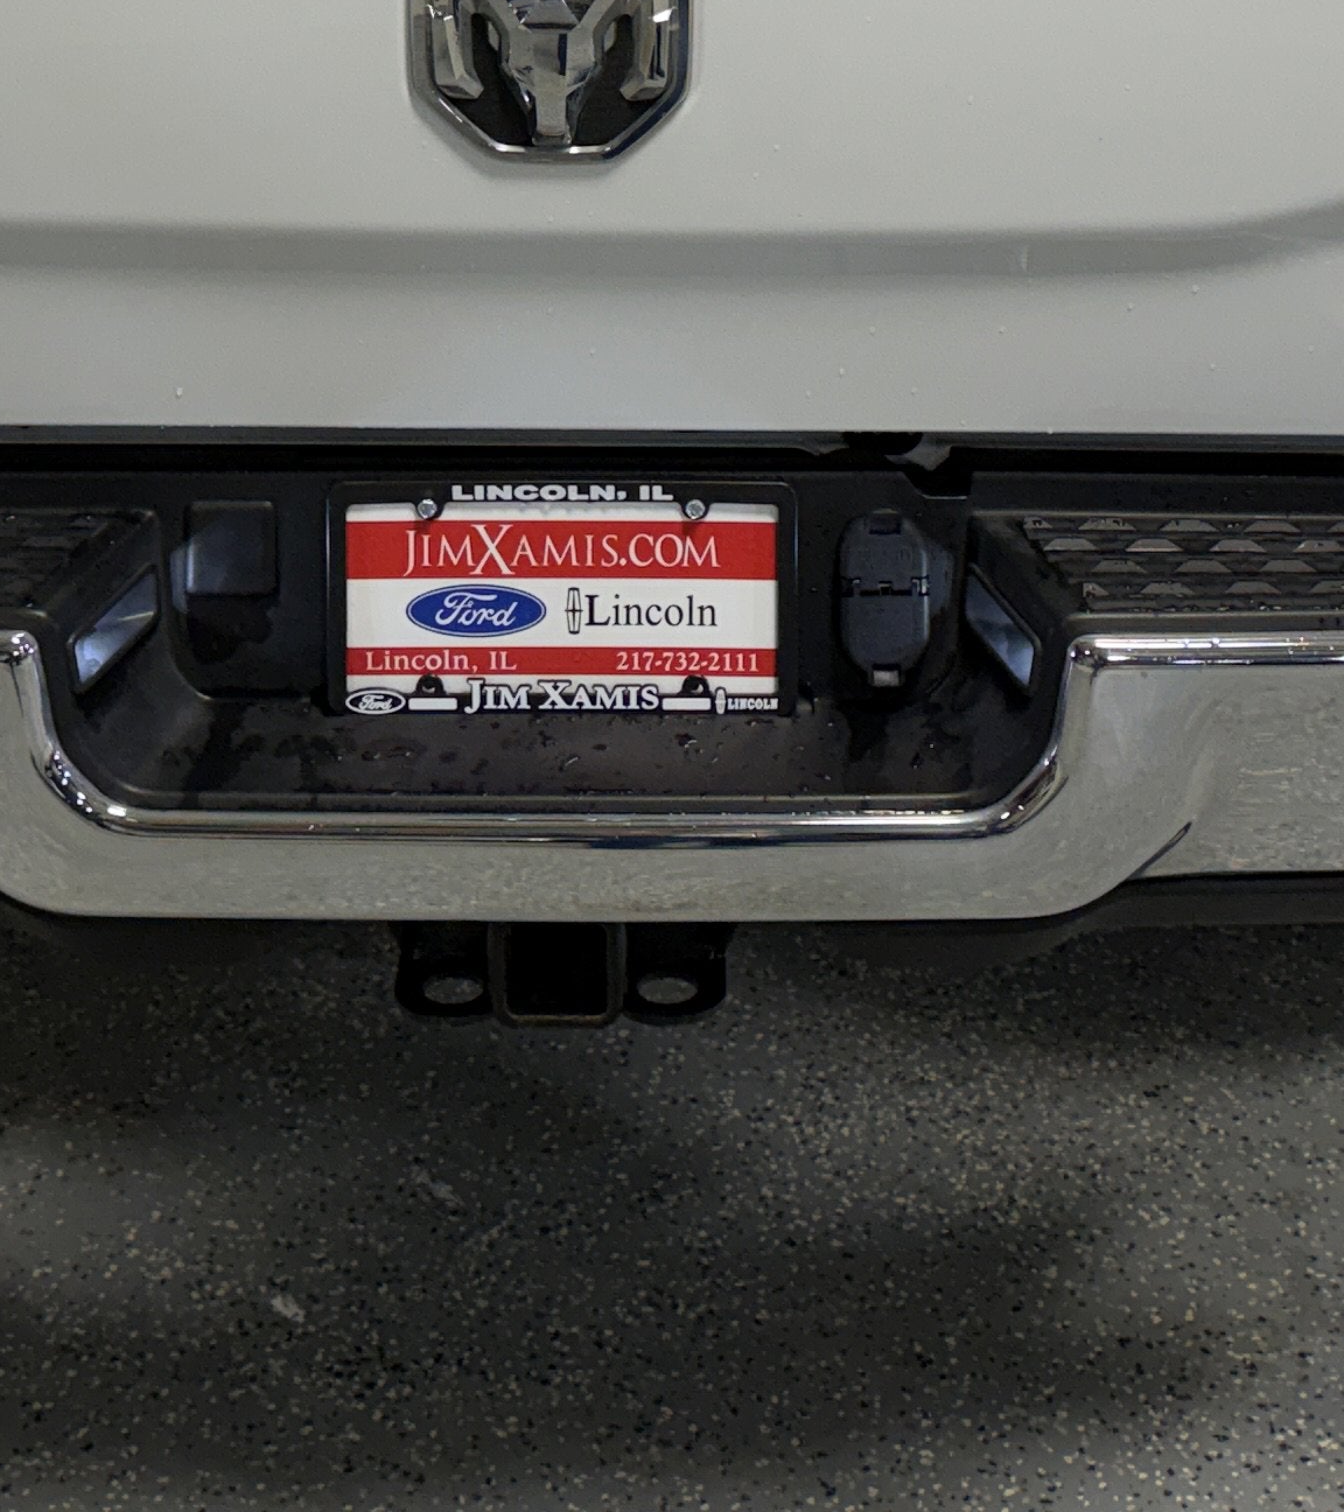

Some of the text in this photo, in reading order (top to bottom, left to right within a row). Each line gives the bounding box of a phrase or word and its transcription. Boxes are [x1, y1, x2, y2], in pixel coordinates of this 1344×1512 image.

[639, 484, 674, 502] IL
[402, 523, 720, 576] JIMXAMIS.COM
[434, 591, 518, 628] Ford
[584, 594, 718, 628] Lincoln
[365, 651, 517, 674] Lincoln, IL
[616, 652, 759, 672] 217-732-2111
[358, 694, 393, 711] Ford
[464, 679, 659, 714] JIM XAMIS
[727, 698, 779, 711] LINCOLN
